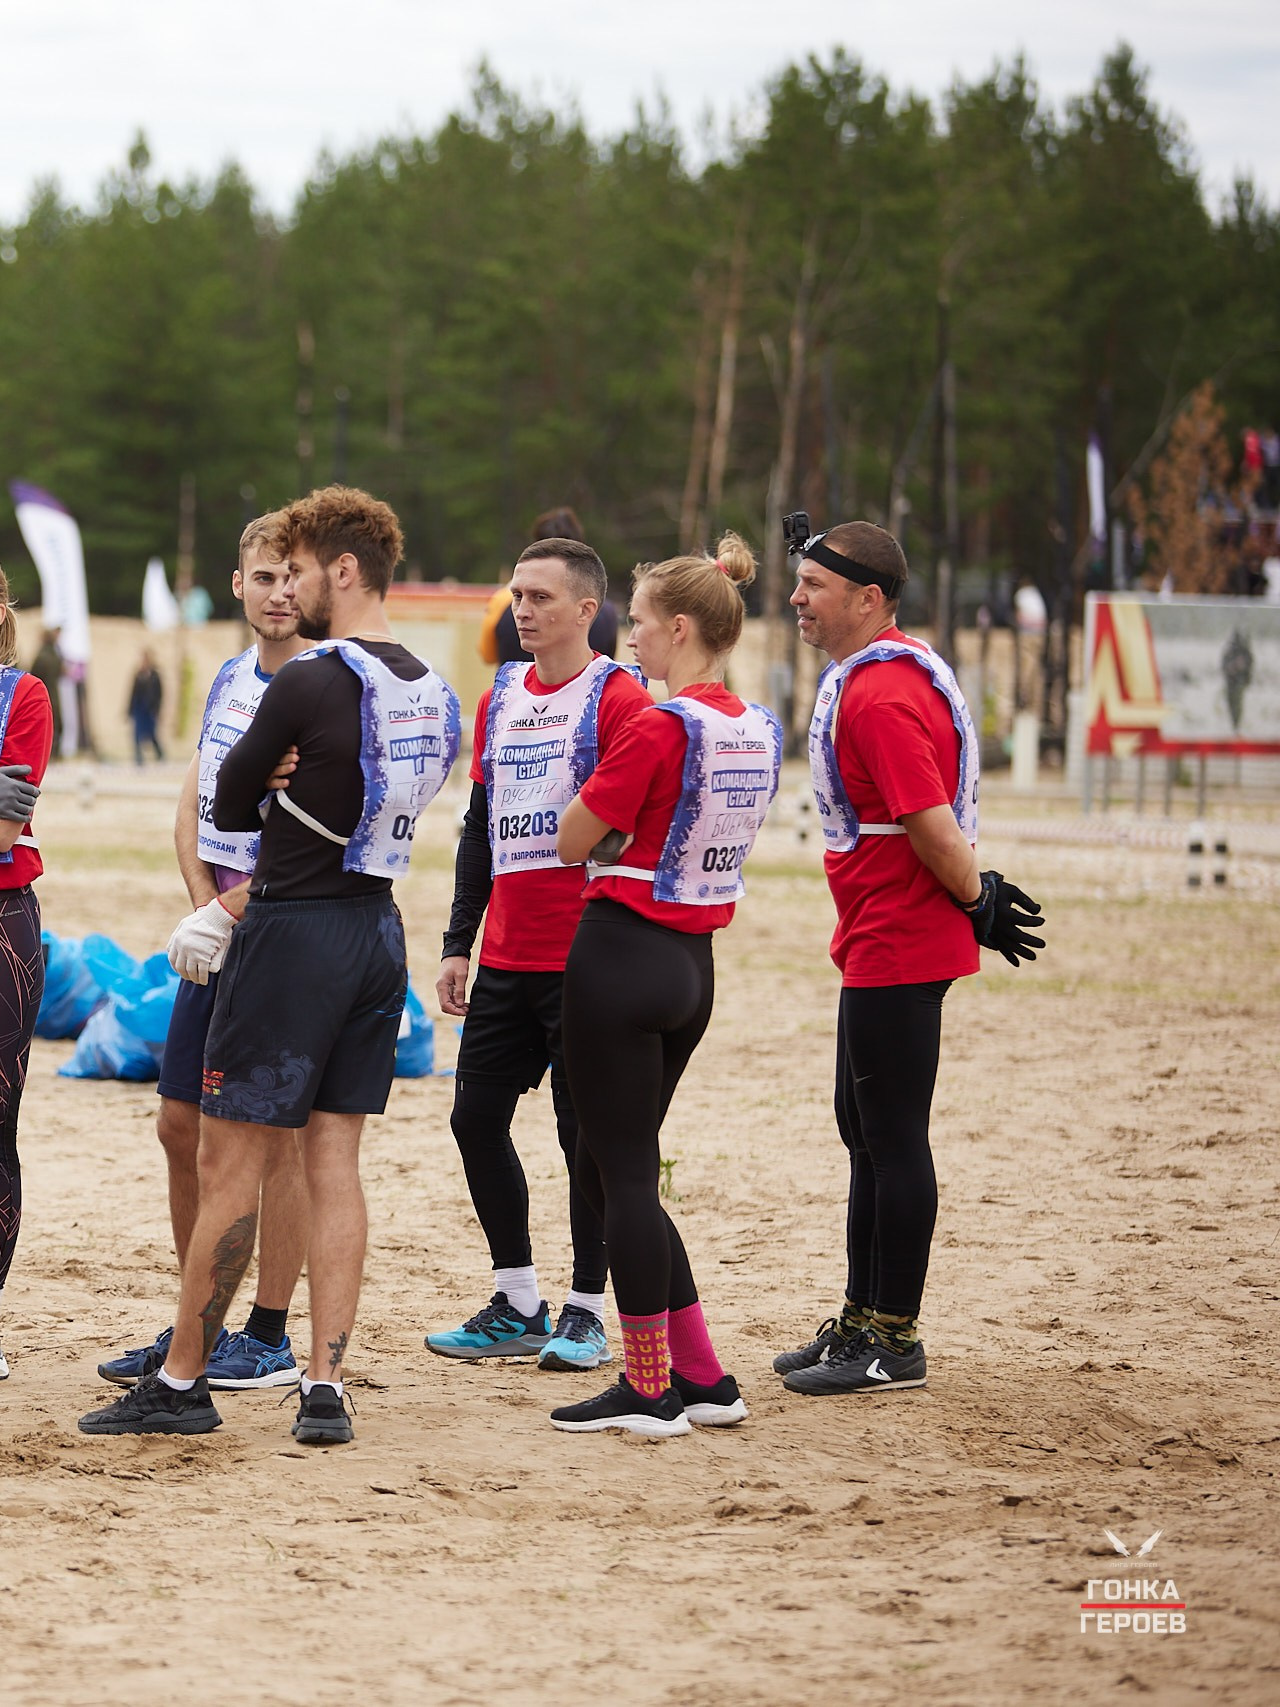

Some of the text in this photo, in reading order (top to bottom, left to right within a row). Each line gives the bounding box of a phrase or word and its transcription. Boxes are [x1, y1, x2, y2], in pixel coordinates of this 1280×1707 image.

[389, 709, 417, 720] ГОНКА
[507, 714, 569, 729] ГОНКА ГЕРОЕВ
[499, 739, 565, 763] КОМАНДНЫЙ
[716, 741, 740, 751] ГОНКА
[518, 761, 547, 779] СТАРТ
[712, 770, 768, 791] КОМАНДНЫЙ
[728, 790, 755, 806] СТАРТ
[499, 810, 558, 841] 03203
[511, 849, 558, 862] ГАЗПРОМБАН
[623, 1329, 667, 1341] RUN
[625, 1341, 668, 1353] RUN
[627, 1354, 669, 1366] RUN
[628, 1366, 671, 1378] RUN
[629, 1378, 672, 1395] RUN
